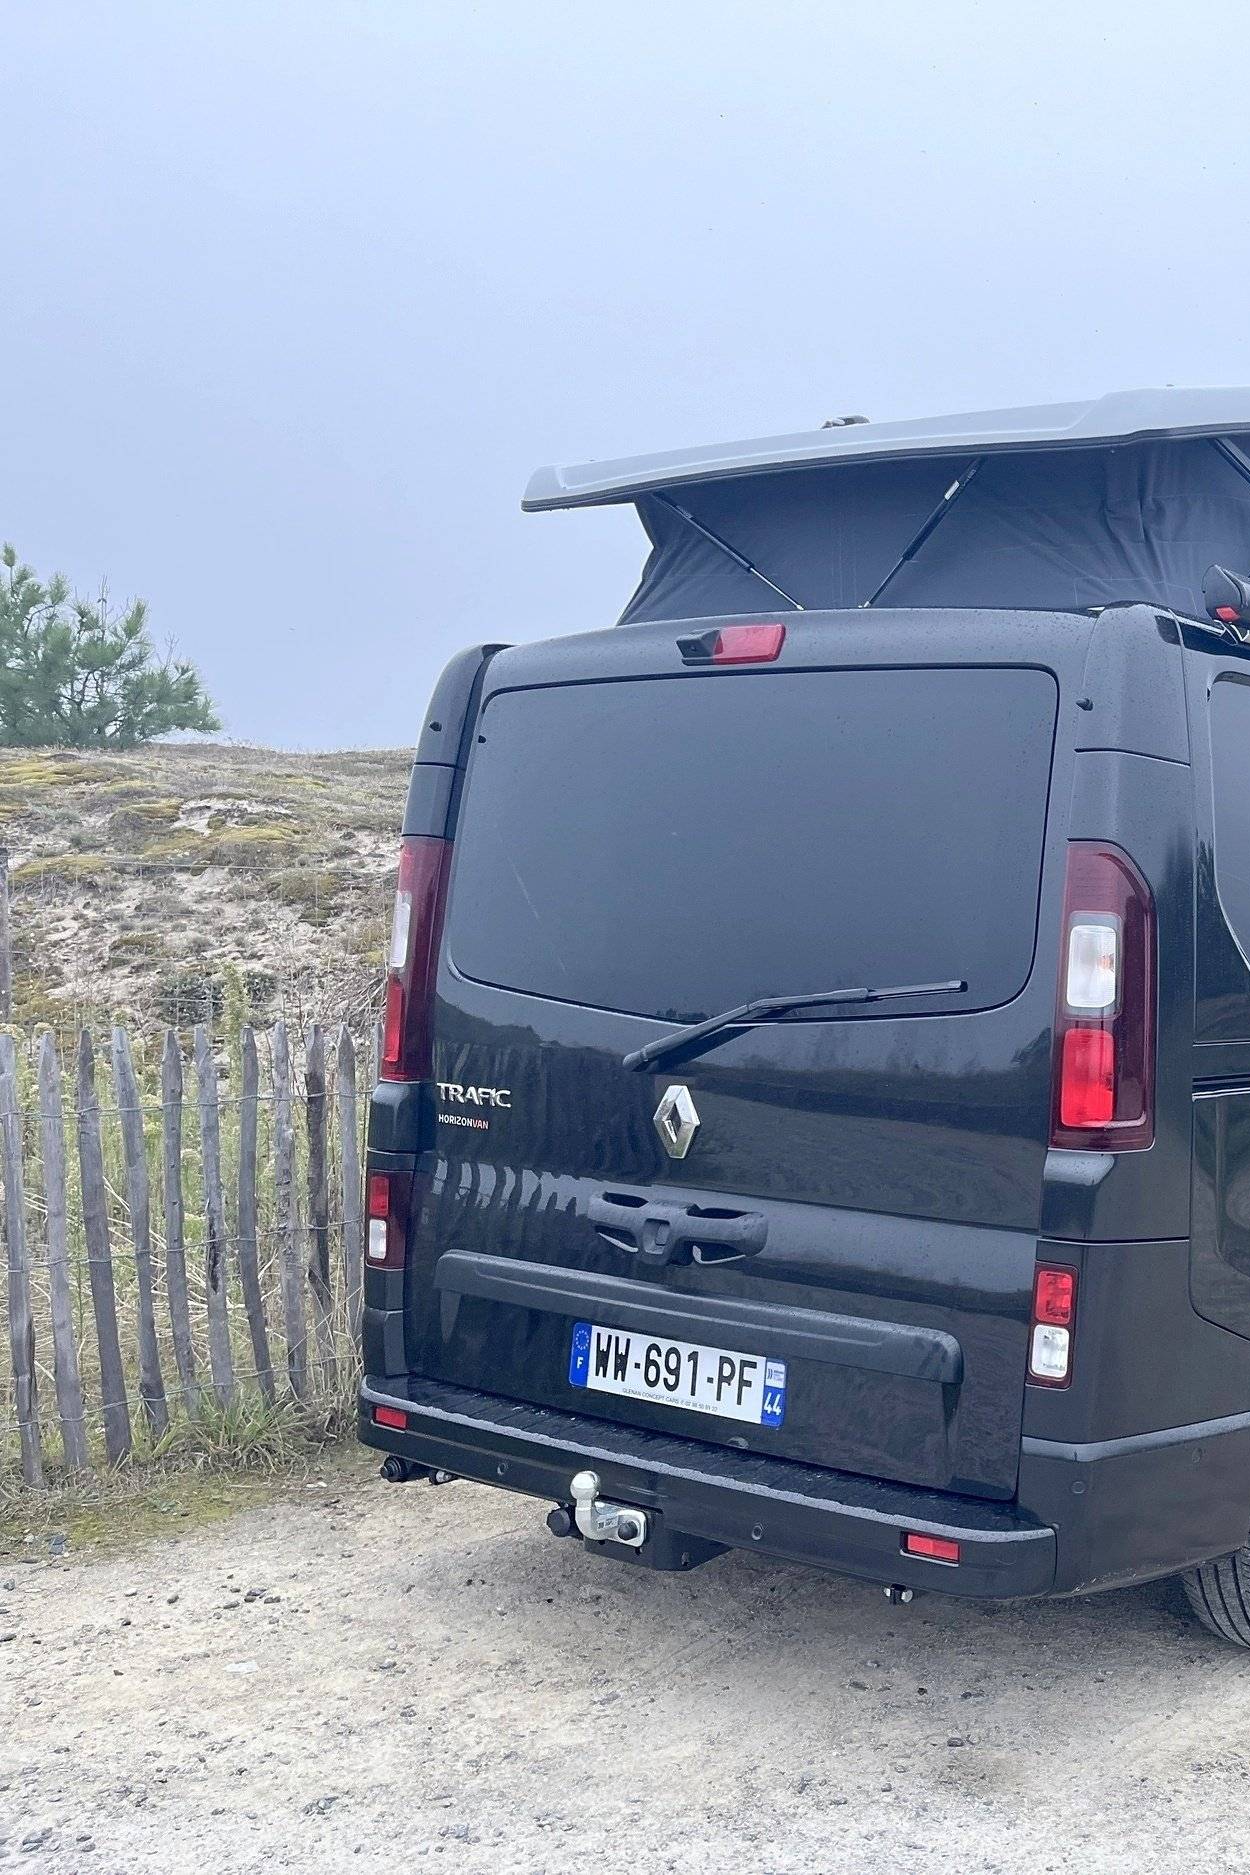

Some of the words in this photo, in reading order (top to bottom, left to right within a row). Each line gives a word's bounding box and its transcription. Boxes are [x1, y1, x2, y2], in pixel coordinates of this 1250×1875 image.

[436, 1082, 512, 1108] TRAFIC
[438, 1113, 489, 1130] HORIZONVAN
[576, 1356, 584, 1369] F
[594, 1332, 758, 1406] WW-691-PF
[763, 1391, 782, 1416] 44
